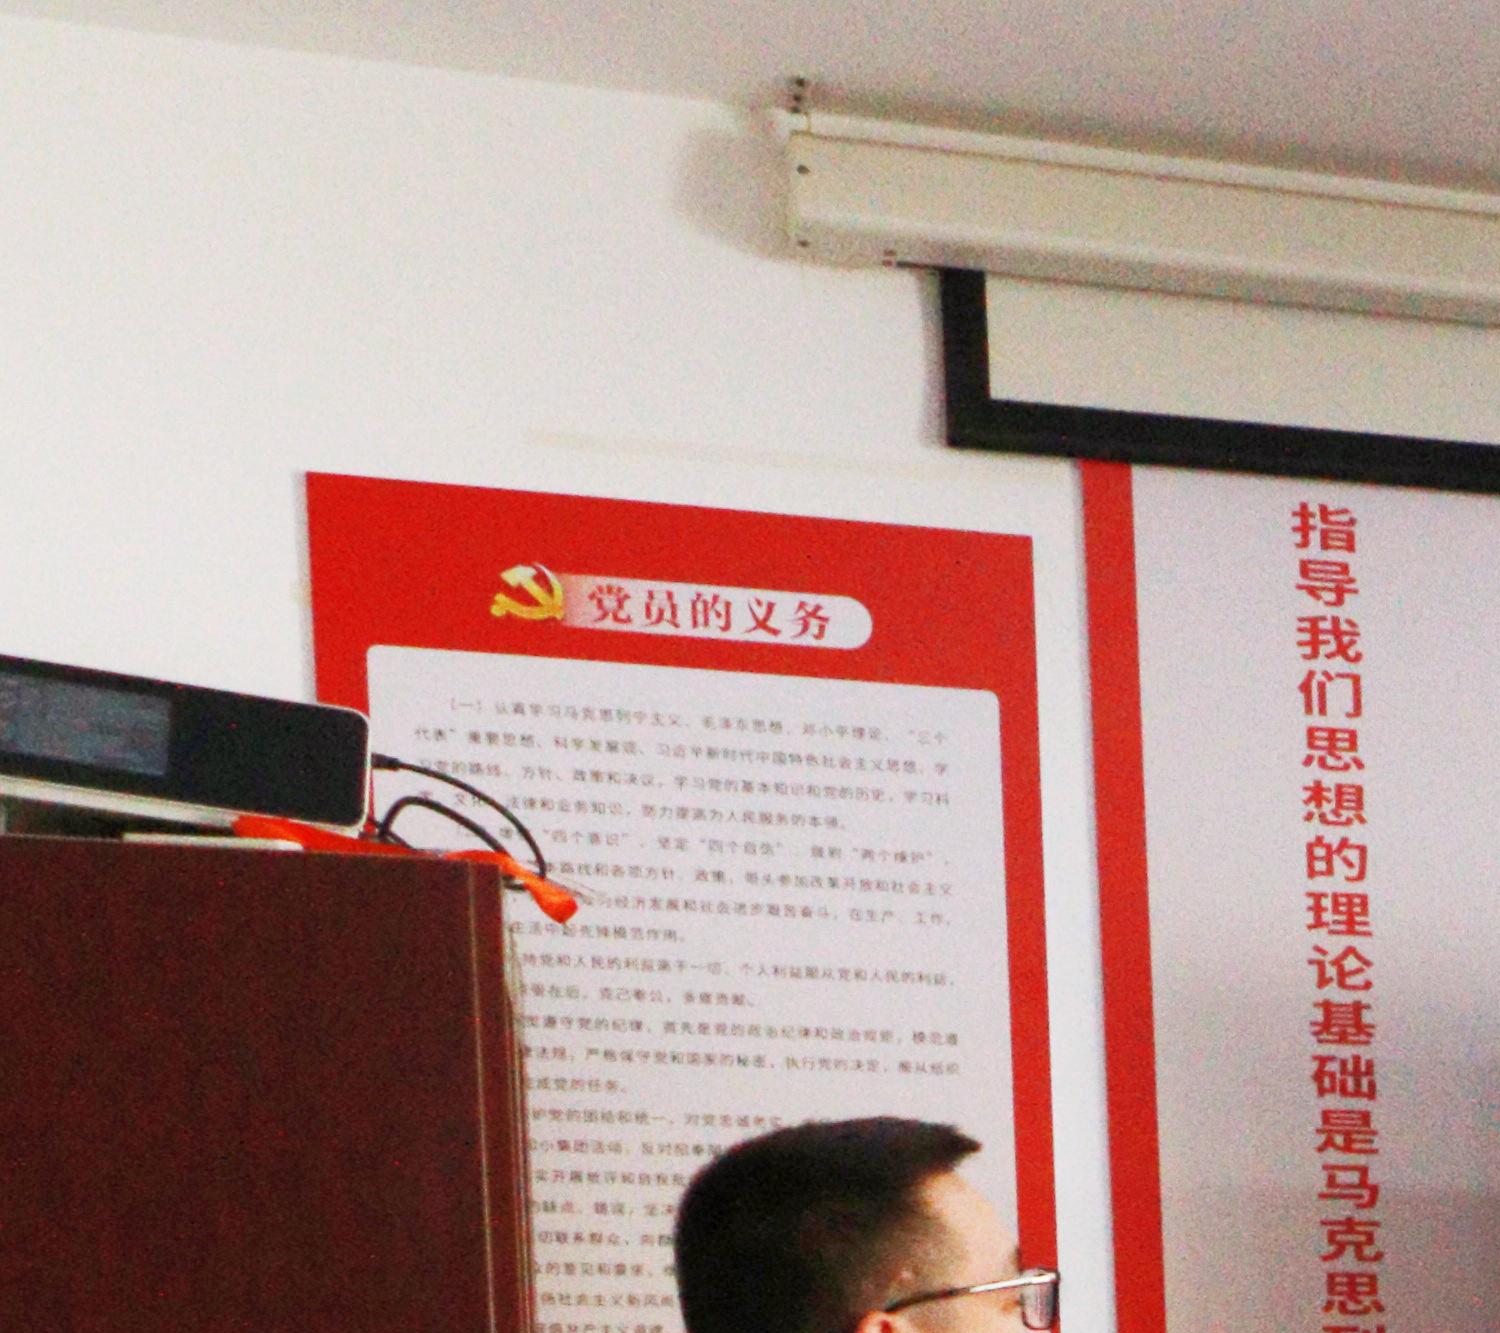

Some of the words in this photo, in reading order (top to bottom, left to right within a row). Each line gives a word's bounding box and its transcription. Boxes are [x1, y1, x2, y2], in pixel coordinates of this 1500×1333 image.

[587, 585, 832, 642] 党员的义务
